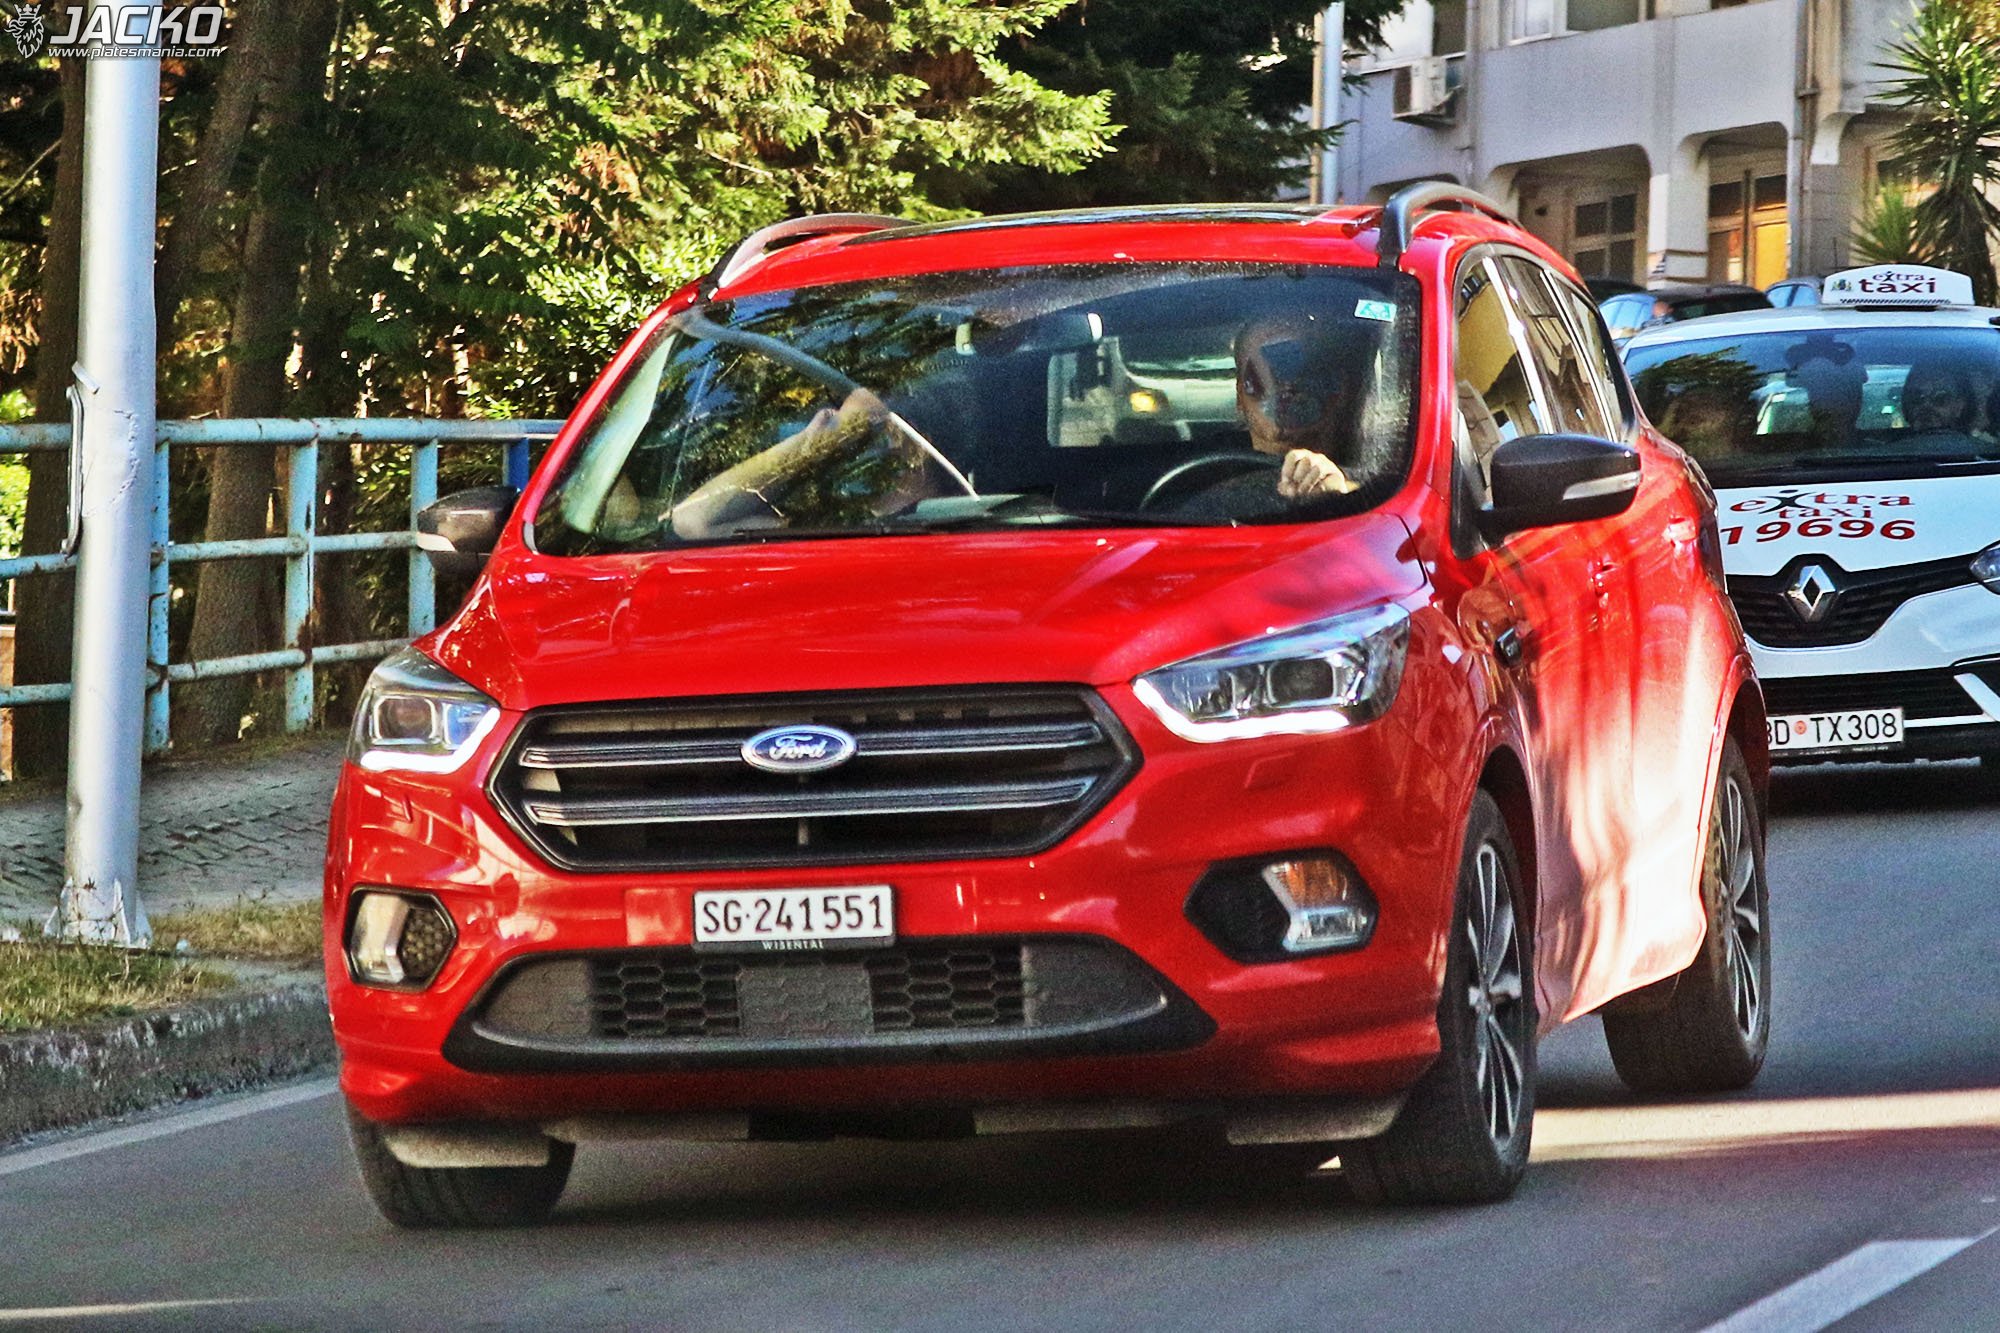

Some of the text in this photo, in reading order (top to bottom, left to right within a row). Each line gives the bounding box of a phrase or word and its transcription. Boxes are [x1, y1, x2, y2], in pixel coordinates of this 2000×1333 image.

[1859, 278, 1936, 294] taxi
[1779, 506, 1873, 519] taxi
[1720, 518, 1915, 545] 19696
[768, 735, 828, 760] Ford
